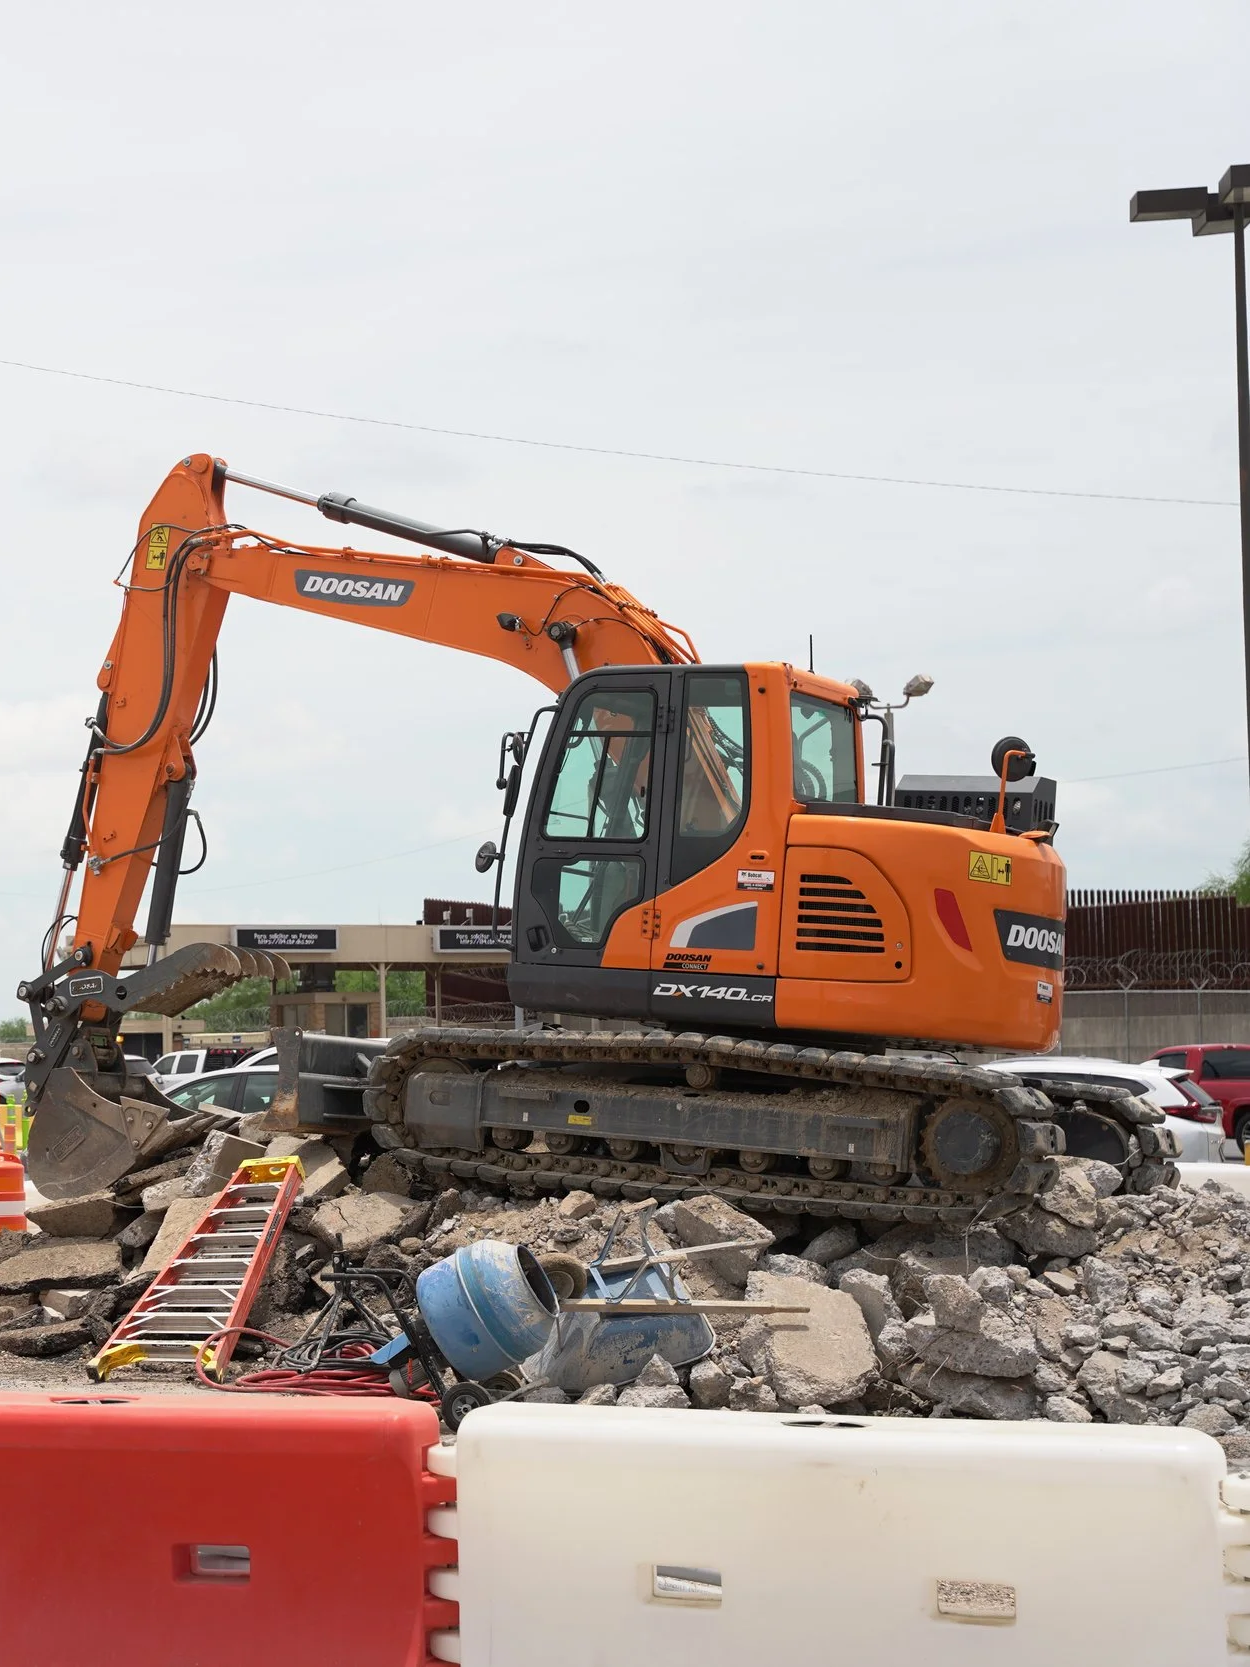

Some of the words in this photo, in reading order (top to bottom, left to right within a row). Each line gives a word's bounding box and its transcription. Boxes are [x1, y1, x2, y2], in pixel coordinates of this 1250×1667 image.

[303, 576, 404, 601] DOOSAN
[1006, 924, 1064, 956] DOOSA
[666, 953, 711, 962] DOOSAN
[681, 962, 707, 970] CONNECT
